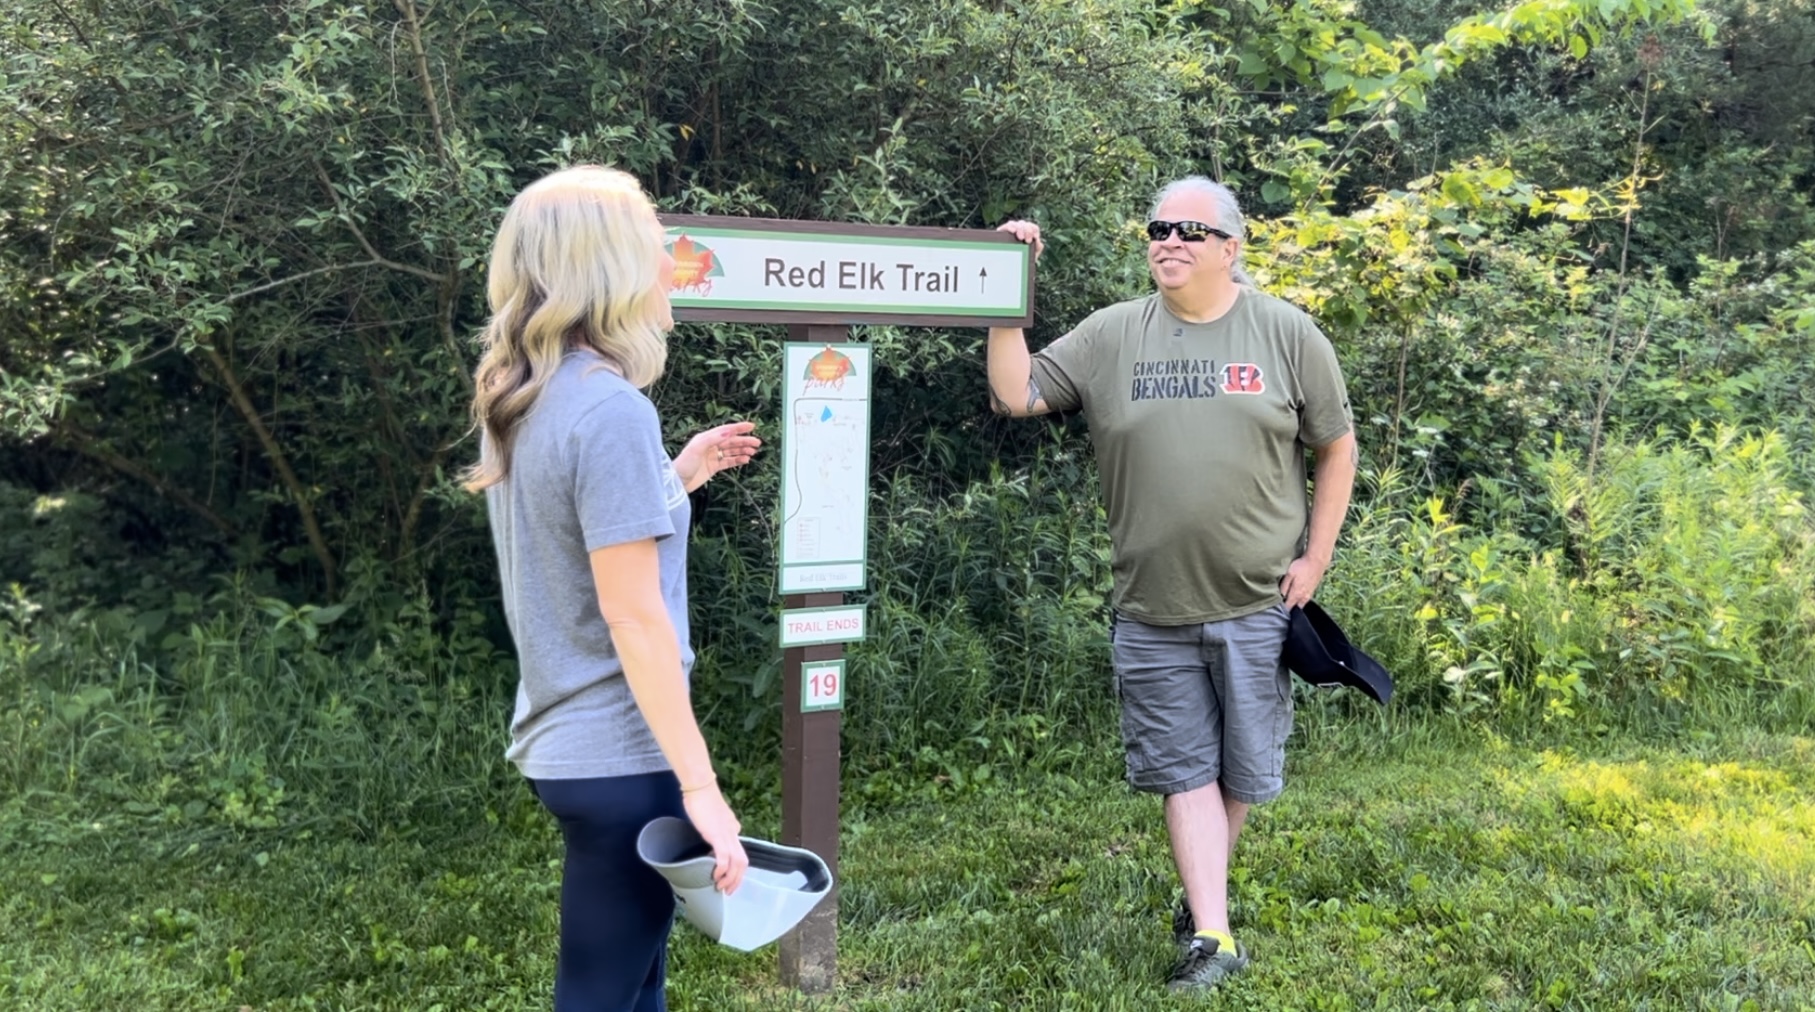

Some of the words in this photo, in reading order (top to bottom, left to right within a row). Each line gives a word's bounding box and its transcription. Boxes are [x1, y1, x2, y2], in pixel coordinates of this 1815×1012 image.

[764, 257, 825, 289] Red
[838, 261, 885, 291] Elk
[896, 263, 959, 293] Trail
[1133, 359, 1215, 376] CINCINNATI
[1131, 375, 1216, 401] BENGALS
[788, 622, 823, 634] TRAIL
[826, 618, 859, 631] ENDS
[809, 674, 837, 697] 19
